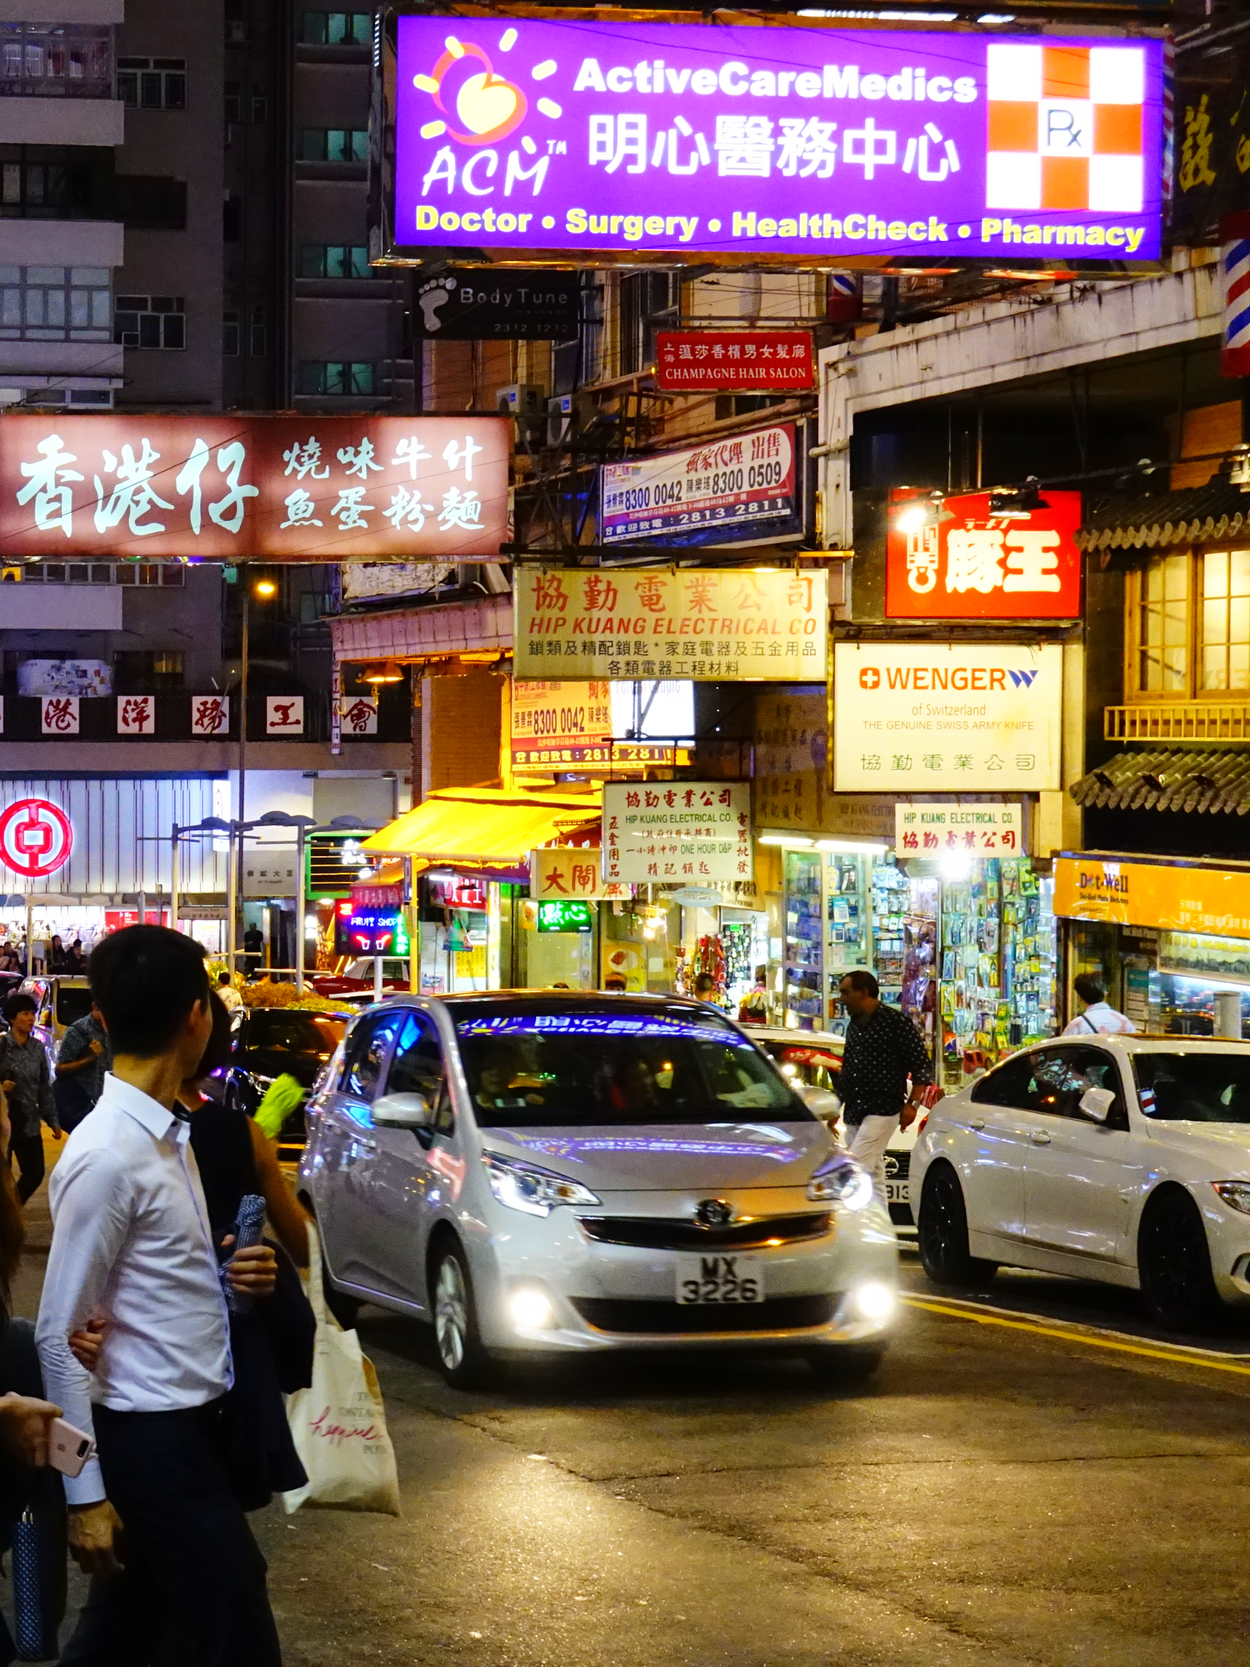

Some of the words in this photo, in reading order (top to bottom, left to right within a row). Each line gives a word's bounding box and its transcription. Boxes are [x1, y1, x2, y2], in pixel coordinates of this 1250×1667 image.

[573, 57, 978, 105] ActiveCareMedics
[588, 112, 961, 184] 明心醫務中心
[422, 146, 548, 197] ACM
[414, 205, 532, 234] Doctor
[565, 209, 699, 243] Surgery
[731, 213, 949, 243] HealthCheck
[981, 218, 1145, 252] Pharmacy
[494, 324, 527, 332] 2312
[664, 342, 675, 363] 上海
[665, 368, 736, 379] CHAMPAGNE
[739, 368, 767, 378] HAIR
[770, 367, 806, 378] SALON
[282, 435, 484, 481] 燒味牛什
[751, 433, 781, 462] 出售
[17, 434, 260, 538] 香港仔
[625, 487, 650, 511] 8300
[654, 480, 683, 504] 0042
[712, 468, 743, 496] 8300
[748, 461, 782, 488] 0509
[280, 487, 485, 532] 魚蛋粉麵
[679, 507, 726, 524] 2813
[735, 498, 783, 515] 2811
[945, 529, 1061, 593] 豚王
[531, 575, 814, 614] 協勤電業公司
[529, 617, 567, 634] HIP
[572, 617, 646, 634] KUANG
[652, 617, 781, 635] ELECTRICAL
[789, 617, 817, 635] CO
[607, 660, 740, 676] 各類電器工程材料
[886, 667, 1007, 690] WENGER
[534, 708, 558, 735] 8300
[560, 706, 585, 733] 0042
[912, 703, 923, 716] of
[926, 703, 986, 716] Switzerland
[863, 721, 883, 730] THE
[886, 721, 933, 730] GENUINE
[936, 721, 969, 730] SWISS
[971, 721, 1000, 730] ARMY
[1004, 721, 1034, 730] KNIFE
[584, 748, 620, 760] 2813
[860, 754, 1035, 771] 協勤電業公司
[625, 789, 732, 809] 協勤電業公司
[626, 815, 638, 824] HIP
[640, 814, 668, 824] KUANG
[669, 813, 718, 823] ELECTRICAL
[904, 812, 917, 824] HIP
[921, 812, 946, 823] KUANG
[950, 812, 998, 823] ELECTRICAL
[609, 816, 620, 878] 五金用品
[680, 845, 695, 854] ONE
[697, 844, 716, 854] HOUR
[902, 830, 1016, 849] 協勤電業公司
[351, 917, 374, 926] FRUIT
[378, 917, 398, 926] SHOP
[682, 1279, 757, 1302] 3226
